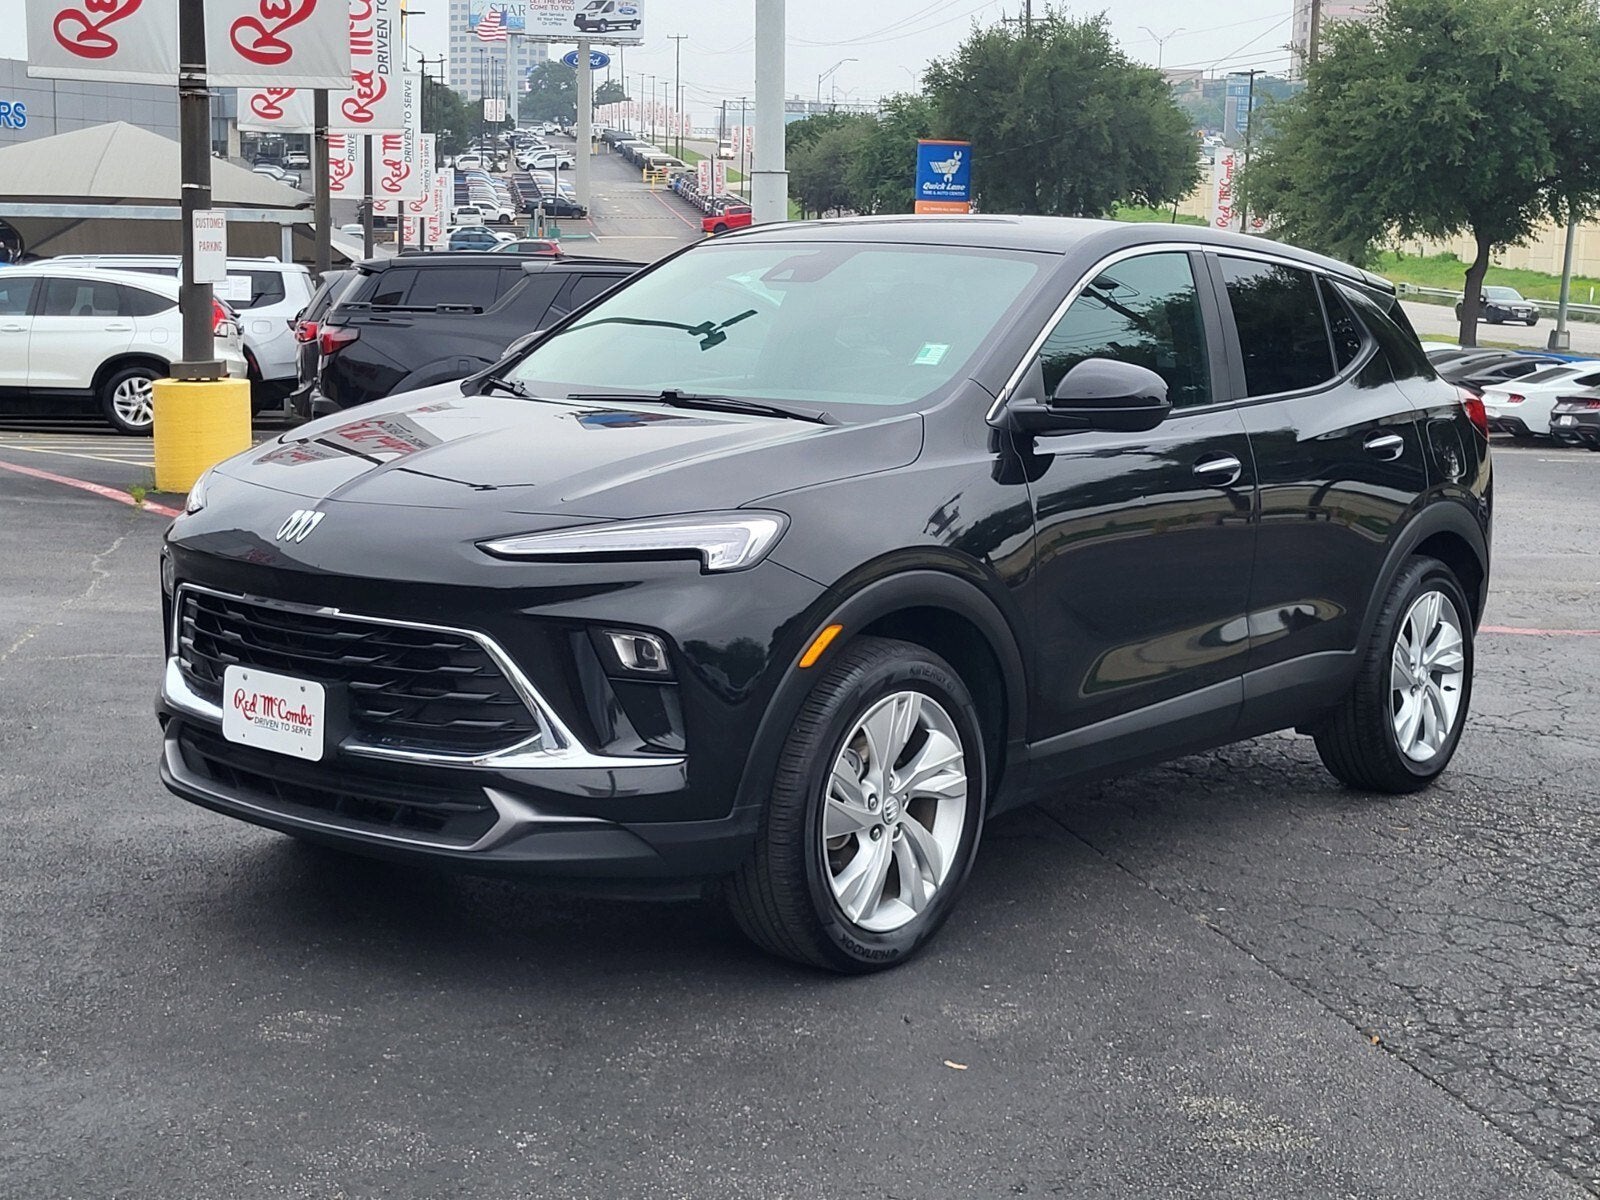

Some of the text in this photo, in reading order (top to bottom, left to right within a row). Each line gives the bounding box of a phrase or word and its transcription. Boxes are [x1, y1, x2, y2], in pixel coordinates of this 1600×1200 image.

[377, 19, 389, 75] DRIVEN
[341, 70, 387, 123] Red
[0, 101, 27, 128] RS
[404, 79, 413, 163] DRIVEN TO SERVE
[347, 134, 355, 162] DRIVE
[381, 159, 410, 193] Red
[923, 182, 946, 190] Quick
[1216, 154, 1236, 228] Red McCombs
[195, 218, 224, 229] CUSTOMER
[199, 241, 222, 252] PARKING
[234, 688, 313, 726] Red McCombs
[254, 716, 312, 737] DRIVEN TO SERVE
